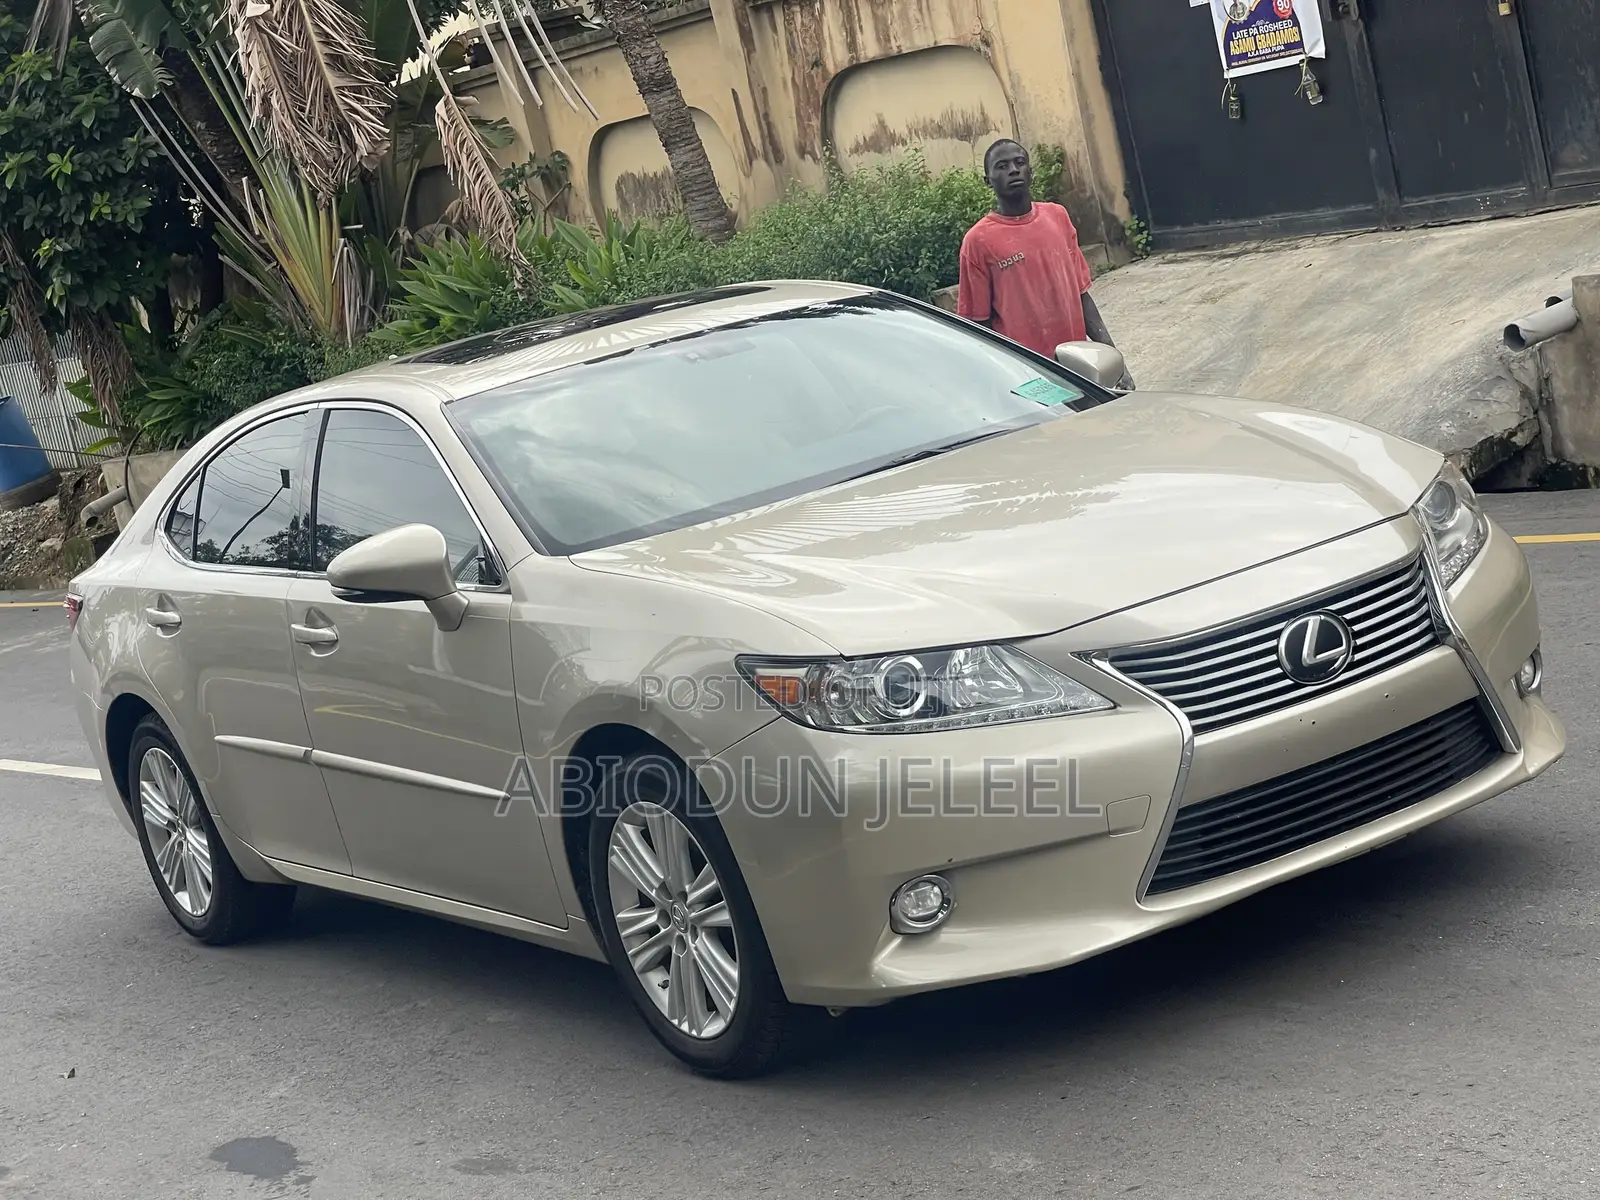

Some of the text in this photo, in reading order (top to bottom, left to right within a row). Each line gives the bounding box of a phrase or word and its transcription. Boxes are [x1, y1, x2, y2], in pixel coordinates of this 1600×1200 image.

[1277, 0, 1290, 10] 90
[1232, 19, 1293, 40] LATE PA ROSHEED
[1229, 26, 1301, 56] ASAMU GBADAMOSI
